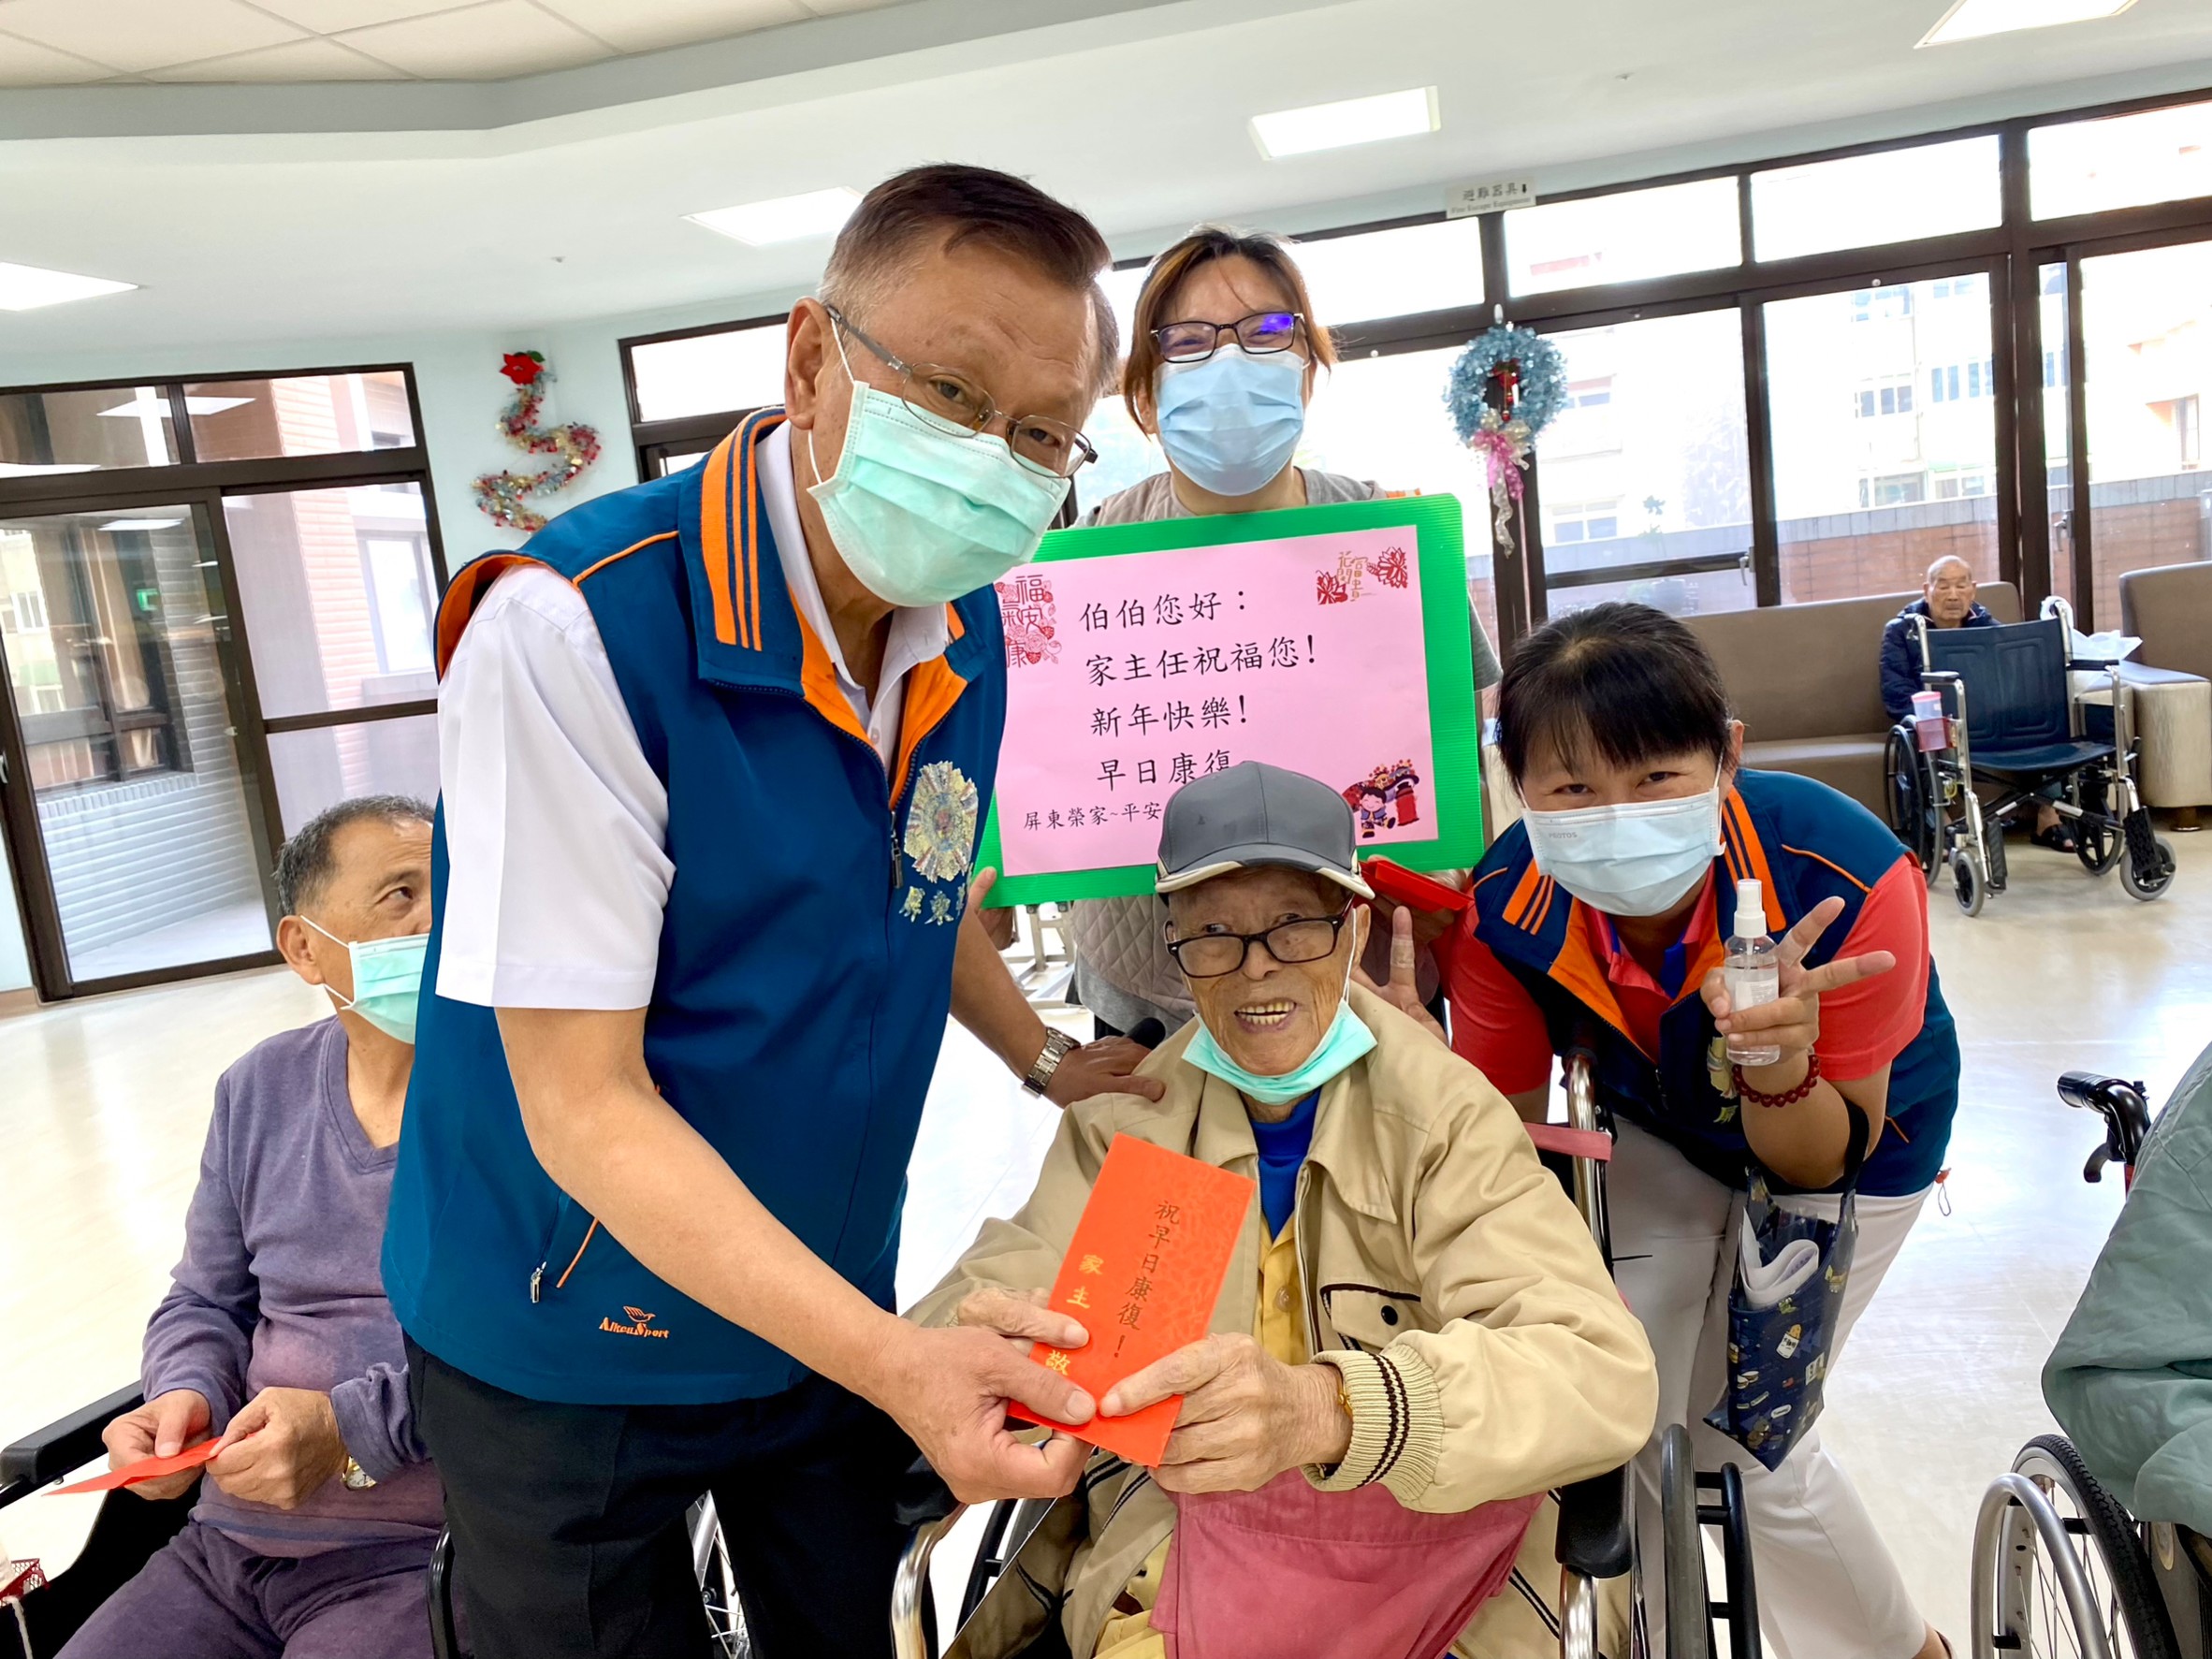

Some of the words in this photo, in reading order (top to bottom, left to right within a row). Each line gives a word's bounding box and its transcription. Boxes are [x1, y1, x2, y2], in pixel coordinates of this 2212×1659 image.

[1079, 589, 1246, 633] 伯伯您好：
[1084, 634, 1317, 688] 家主任祝福您!
[1090, 694, 1247, 738] 新年快樂!
[1113, 1200, 1181, 1358] 祝早日康復!
[1044, 1254, 1104, 1376] 家主敬
